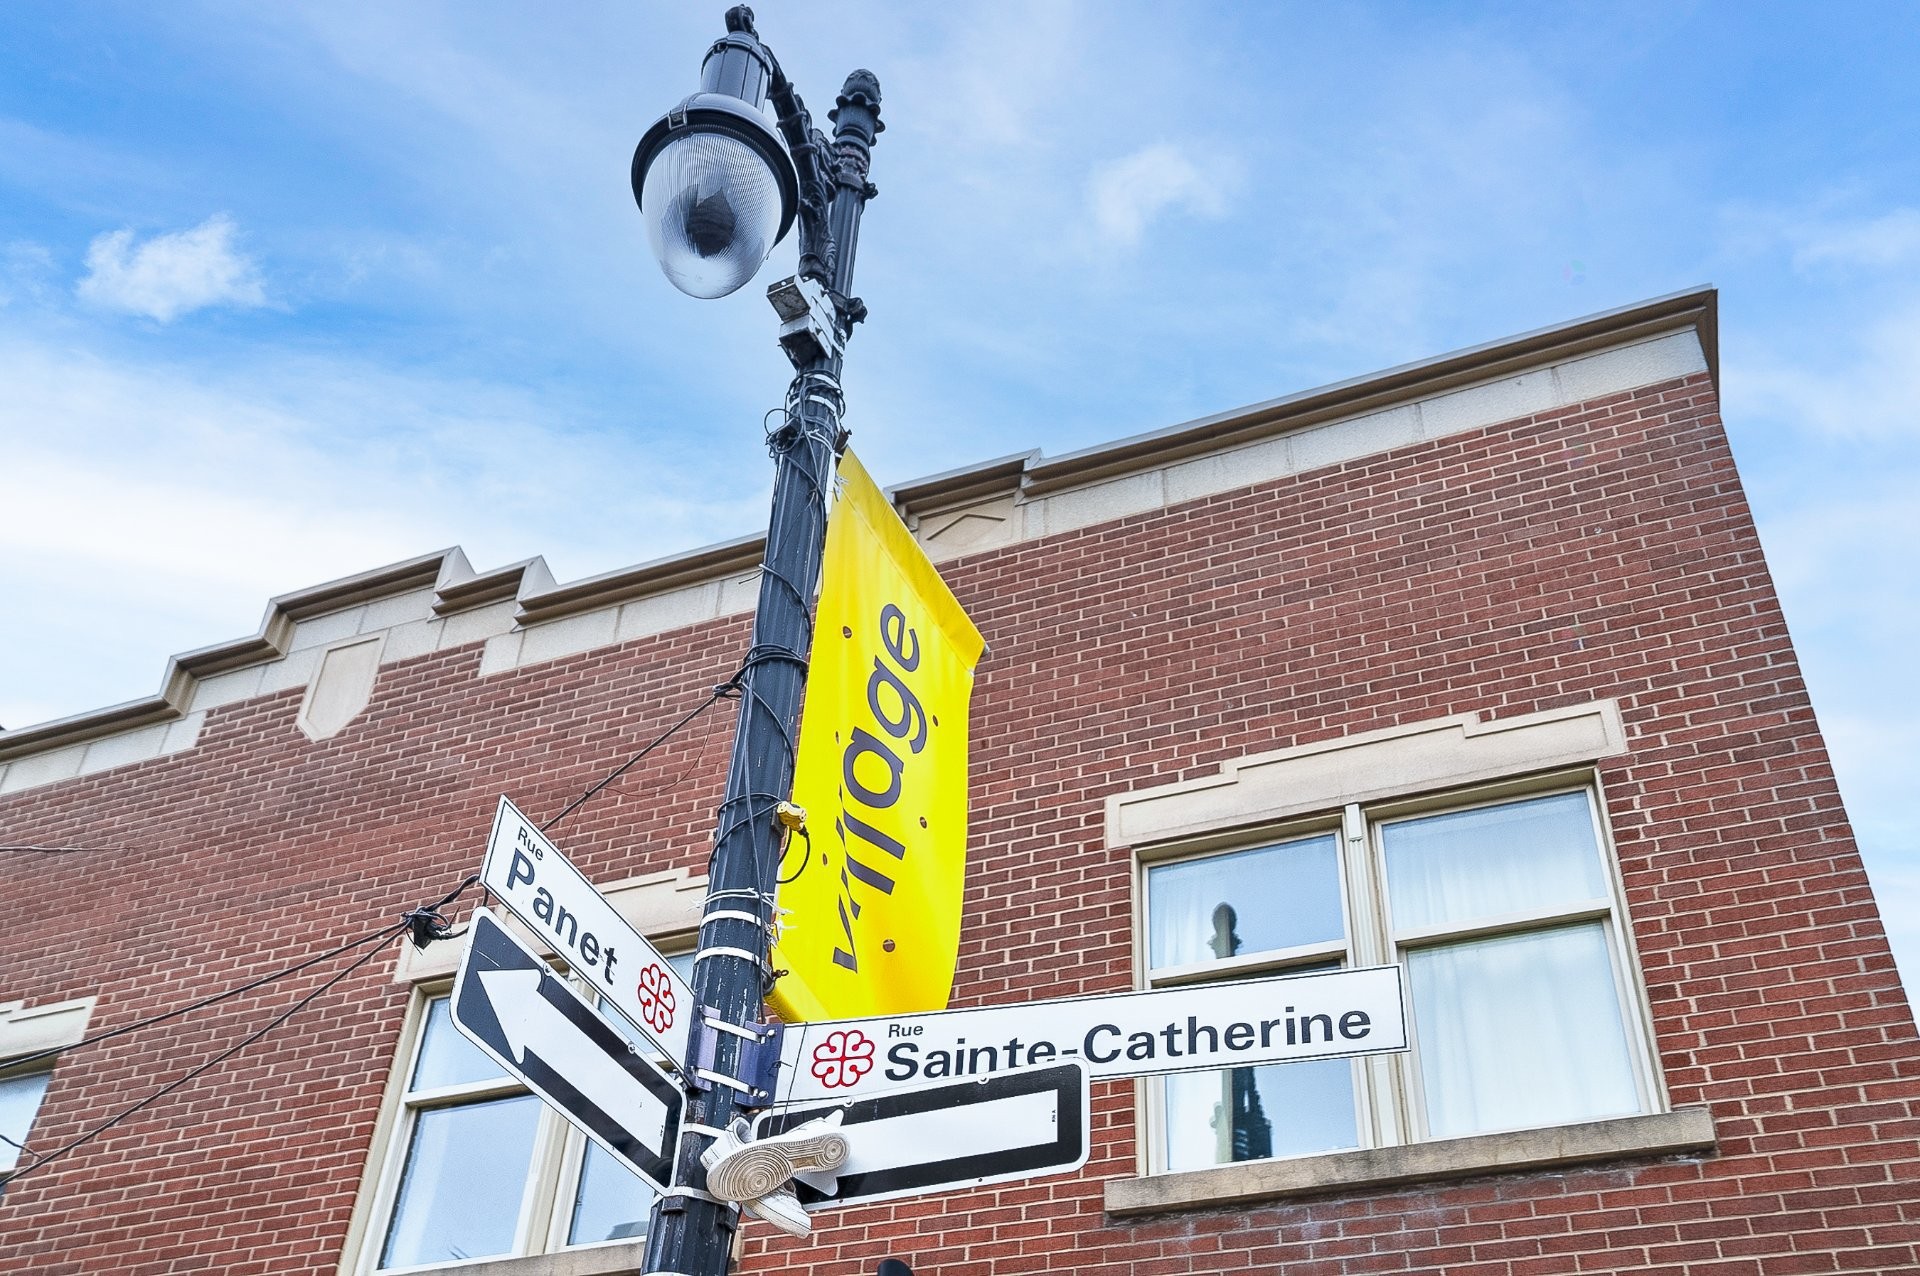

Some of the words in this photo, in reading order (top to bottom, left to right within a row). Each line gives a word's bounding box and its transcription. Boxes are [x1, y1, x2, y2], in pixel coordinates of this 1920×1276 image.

[517, 826, 543, 860] Rue
[506, 848, 618, 985] Panet
[885, 1006, 1371, 1081] Sainte-Catherine
[888, 1024, 924, 1038] Rue
